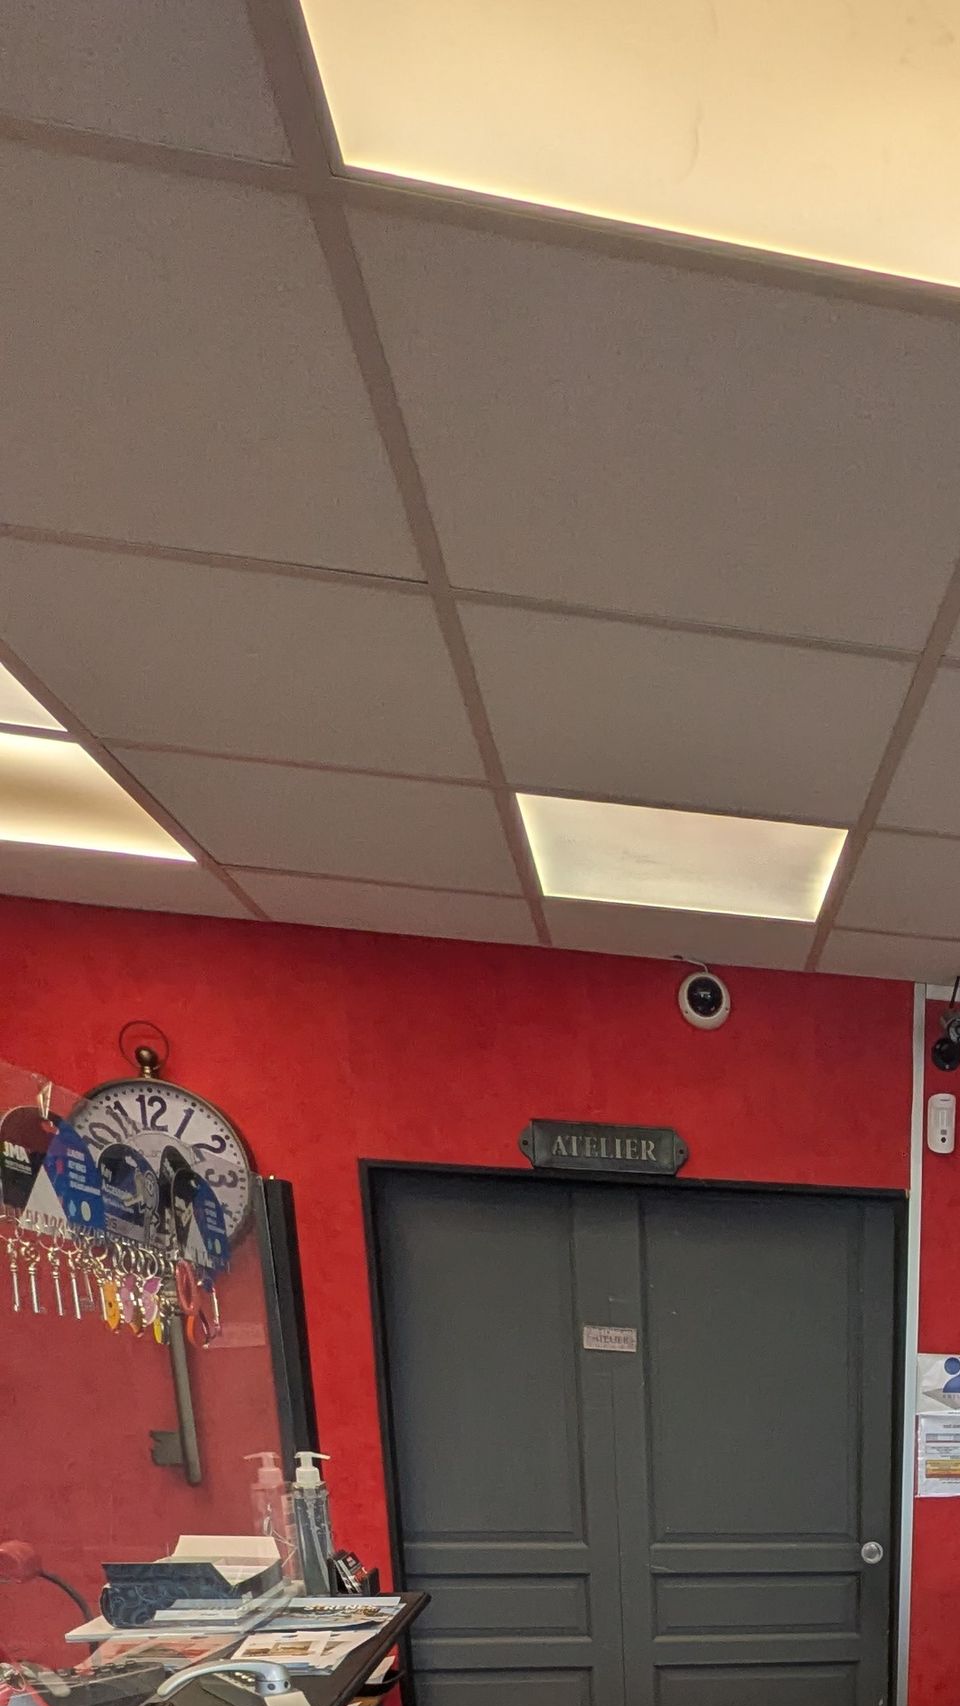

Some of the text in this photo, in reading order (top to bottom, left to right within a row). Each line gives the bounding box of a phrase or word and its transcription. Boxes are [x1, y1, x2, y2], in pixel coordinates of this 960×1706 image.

[136, 1095, 169, 1132] 12
[175, 1107, 195, 1139] 1
[552, 1135, 657, 1162] ATELIER
